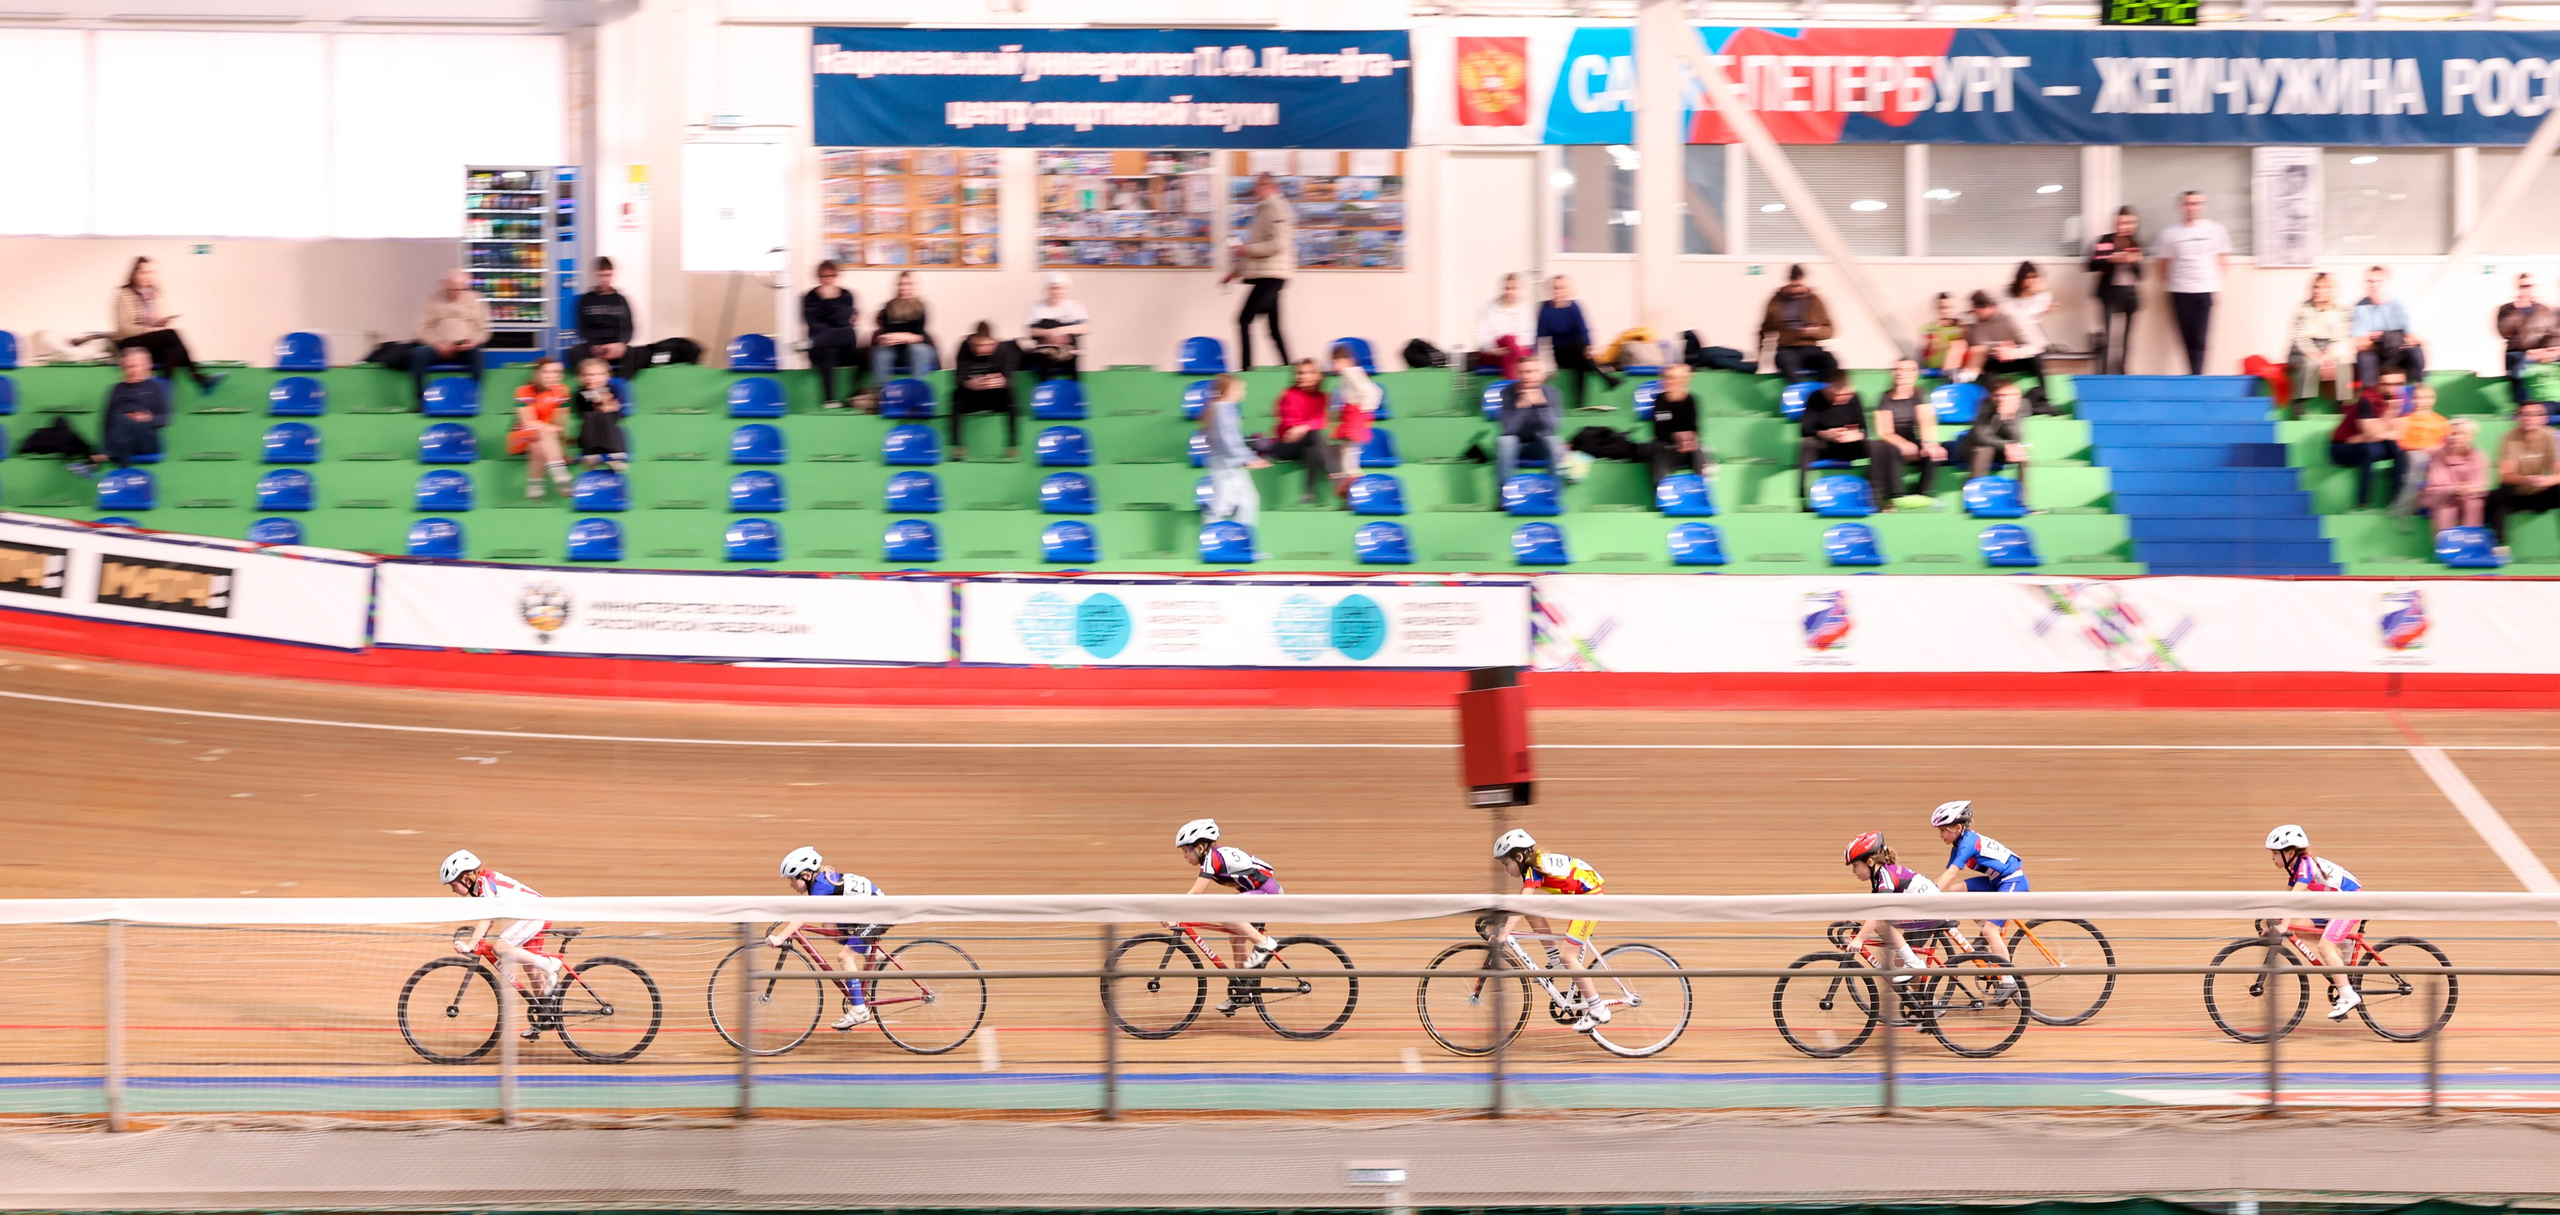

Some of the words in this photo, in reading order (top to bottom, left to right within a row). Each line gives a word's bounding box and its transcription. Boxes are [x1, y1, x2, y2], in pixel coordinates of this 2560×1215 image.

[1022, 52, 1196, 82] университет
[2091, 57, 2428, 115] ЖЕМЧУЖИНА
[1231, 851, 1241, 863] 5
[1548, 857, 1564, 868] 18
[2326, 865, 2334, 878] 2
[850, 879, 866, 894] 21
[1194, 935, 1217, 960] LOKO
[2294, 938, 2317, 962] LOKO
